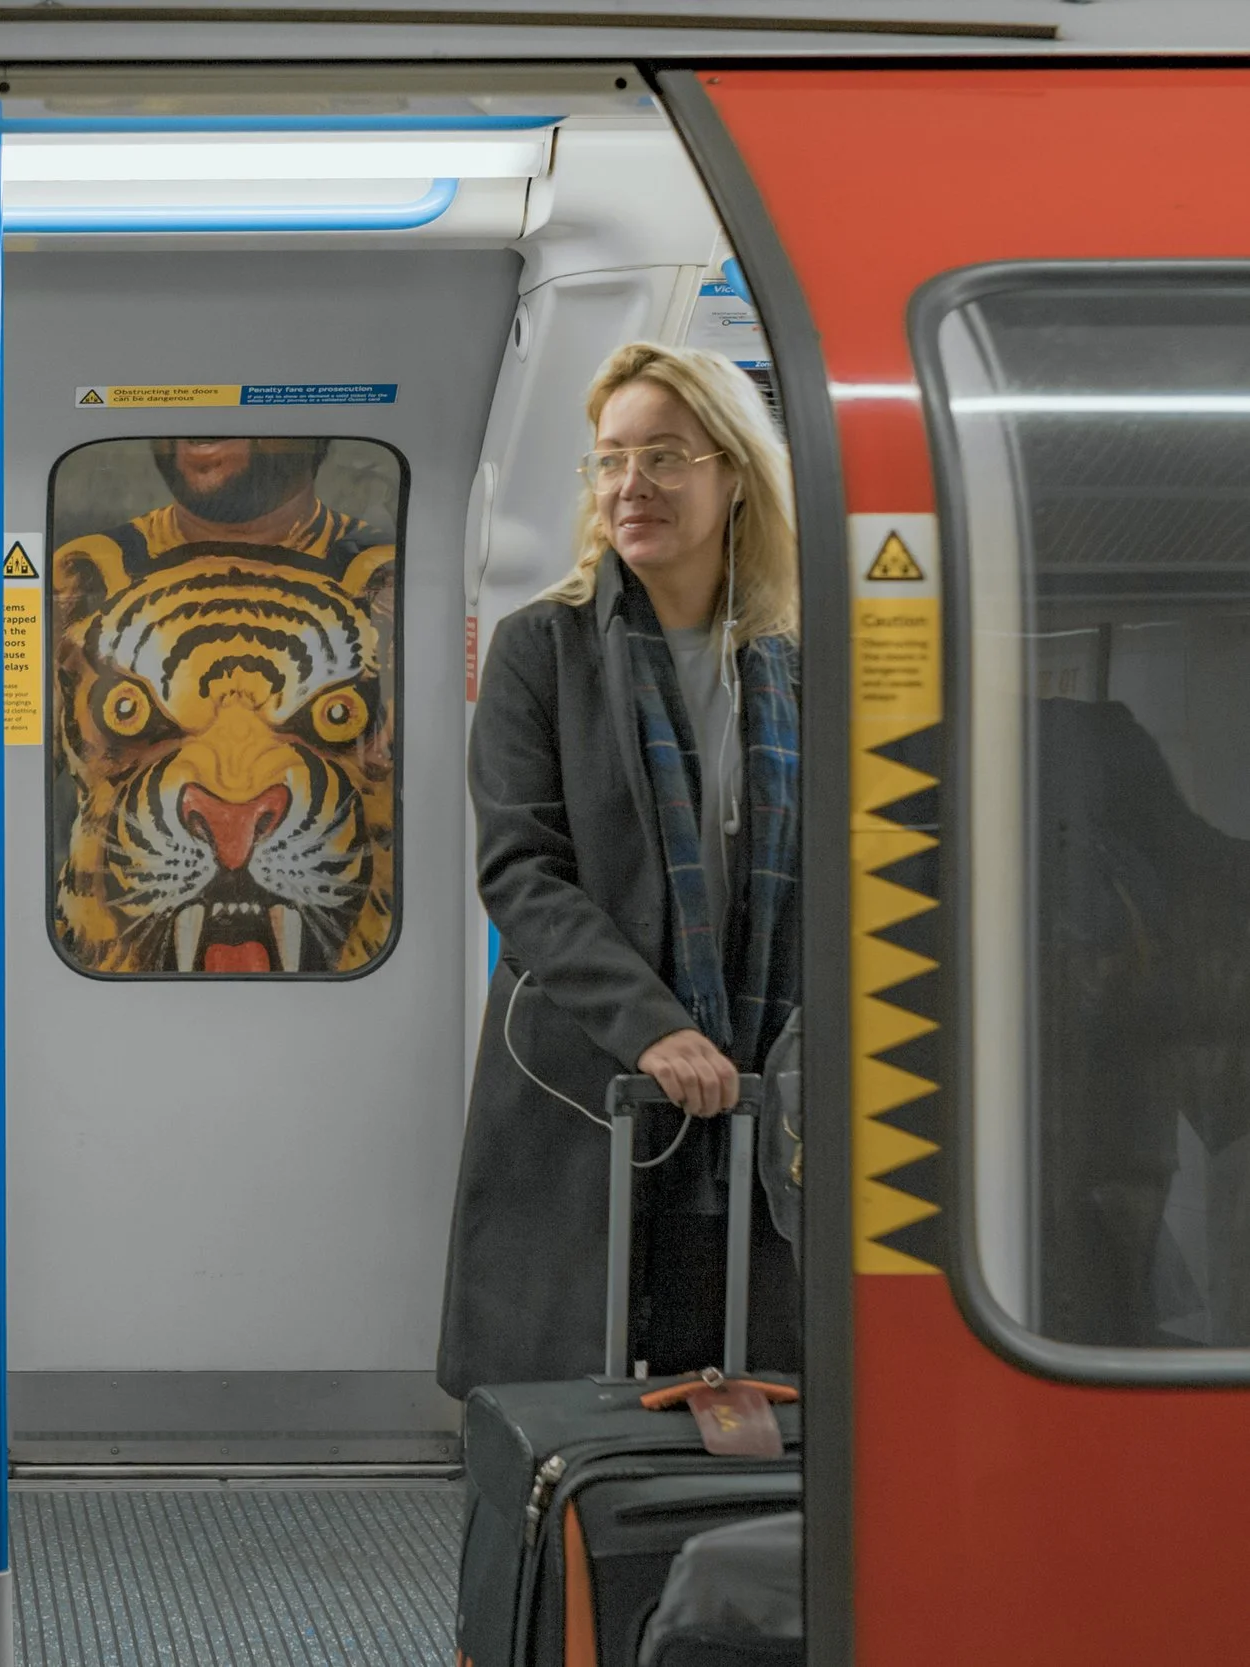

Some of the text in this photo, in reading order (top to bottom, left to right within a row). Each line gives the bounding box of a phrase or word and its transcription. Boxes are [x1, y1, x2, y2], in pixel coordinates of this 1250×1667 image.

[3, 604, 25, 612] ems
[3, 616, 36, 625] rapped
[10, 627, 26, 635] the
[4, 663, 29, 672] elays
